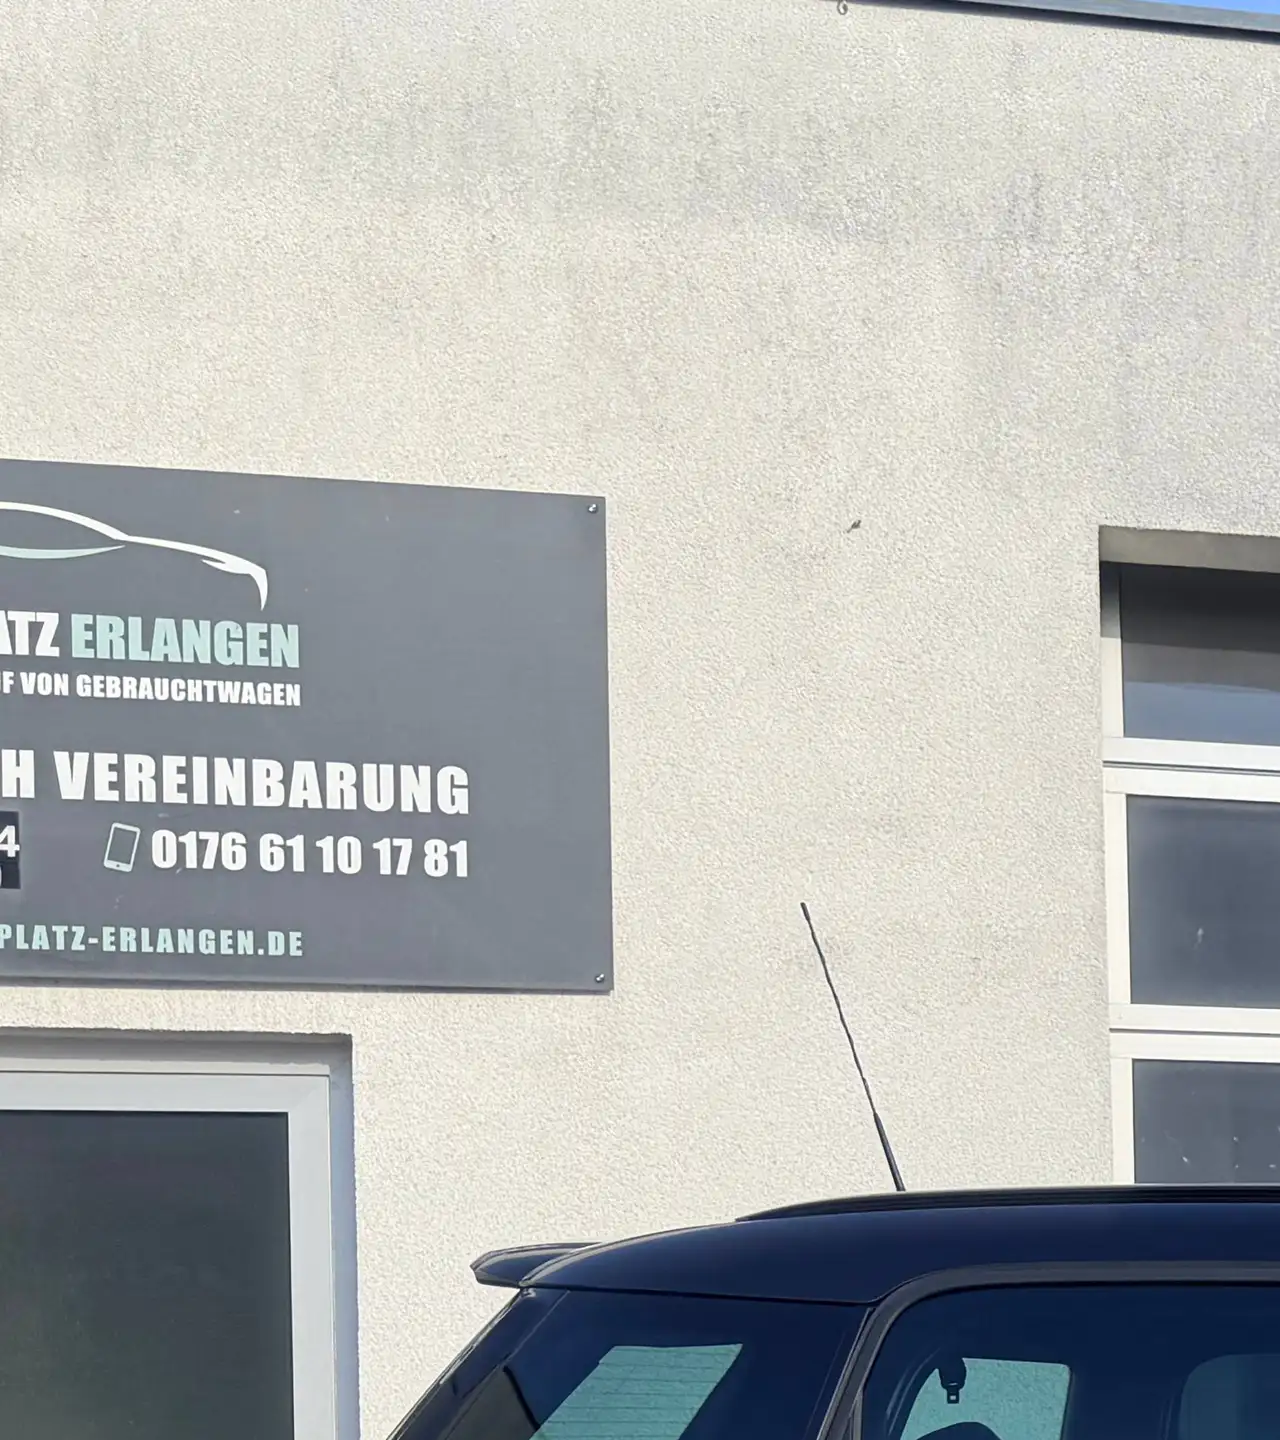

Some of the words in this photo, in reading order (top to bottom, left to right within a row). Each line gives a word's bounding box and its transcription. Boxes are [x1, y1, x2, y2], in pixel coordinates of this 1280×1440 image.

[71, 613, 300, 668] ERLANGEN
[20, 671, 70, 696] VON
[76, 674, 301, 707] GEBRAUCHTWAGEN
[53, 750, 470, 815] VEREINBARUNG
[151, 829, 247, 871] 0176
[259, 834, 305, 873] 61
[316, 836, 362, 874] 10
[374, 838, 413, 876] 17
[424, 839, 469, 878] 81
[0, 924, 304, 957] PLATZ-ERLANGEN.DE
